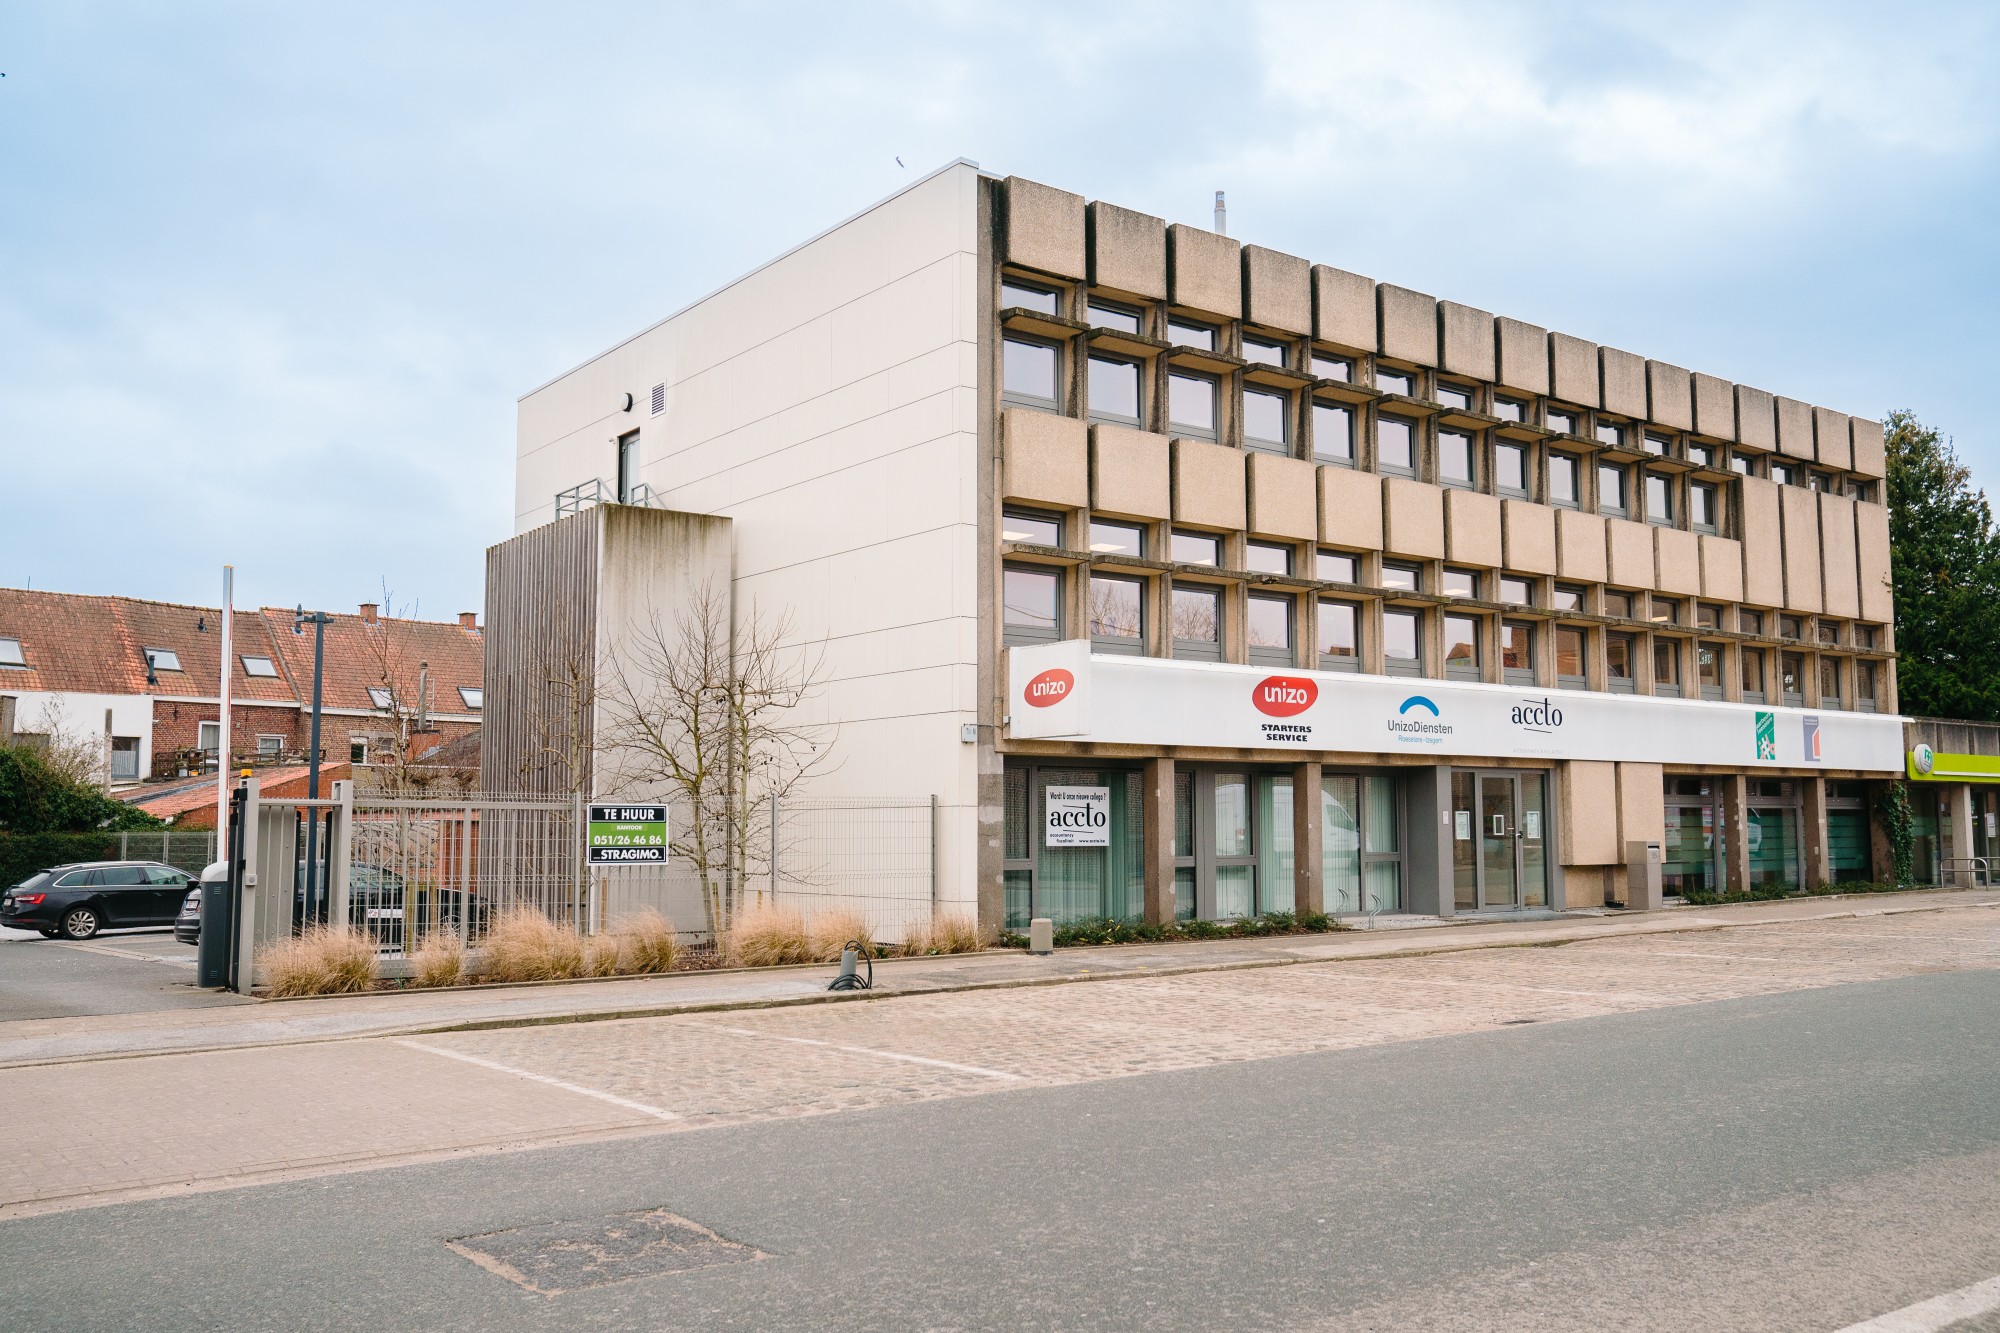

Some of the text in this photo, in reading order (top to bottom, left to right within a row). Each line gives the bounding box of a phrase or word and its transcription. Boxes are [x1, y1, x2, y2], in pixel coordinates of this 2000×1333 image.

[1033, 677, 1066, 697] unizo
[1264, 681, 1308, 705] unizo
[1511, 697, 1563, 727] accto
[1261, 723, 1312, 733] STARTERS
[1387, 719, 1453, 735] UnizoDiensten
[1266, 733, 1308, 742] SERVICE
[603, 808, 655, 820] TE HUUR
[1050, 802, 1106, 828] accto
[593, 834, 662, 845] 051/26 46 86
